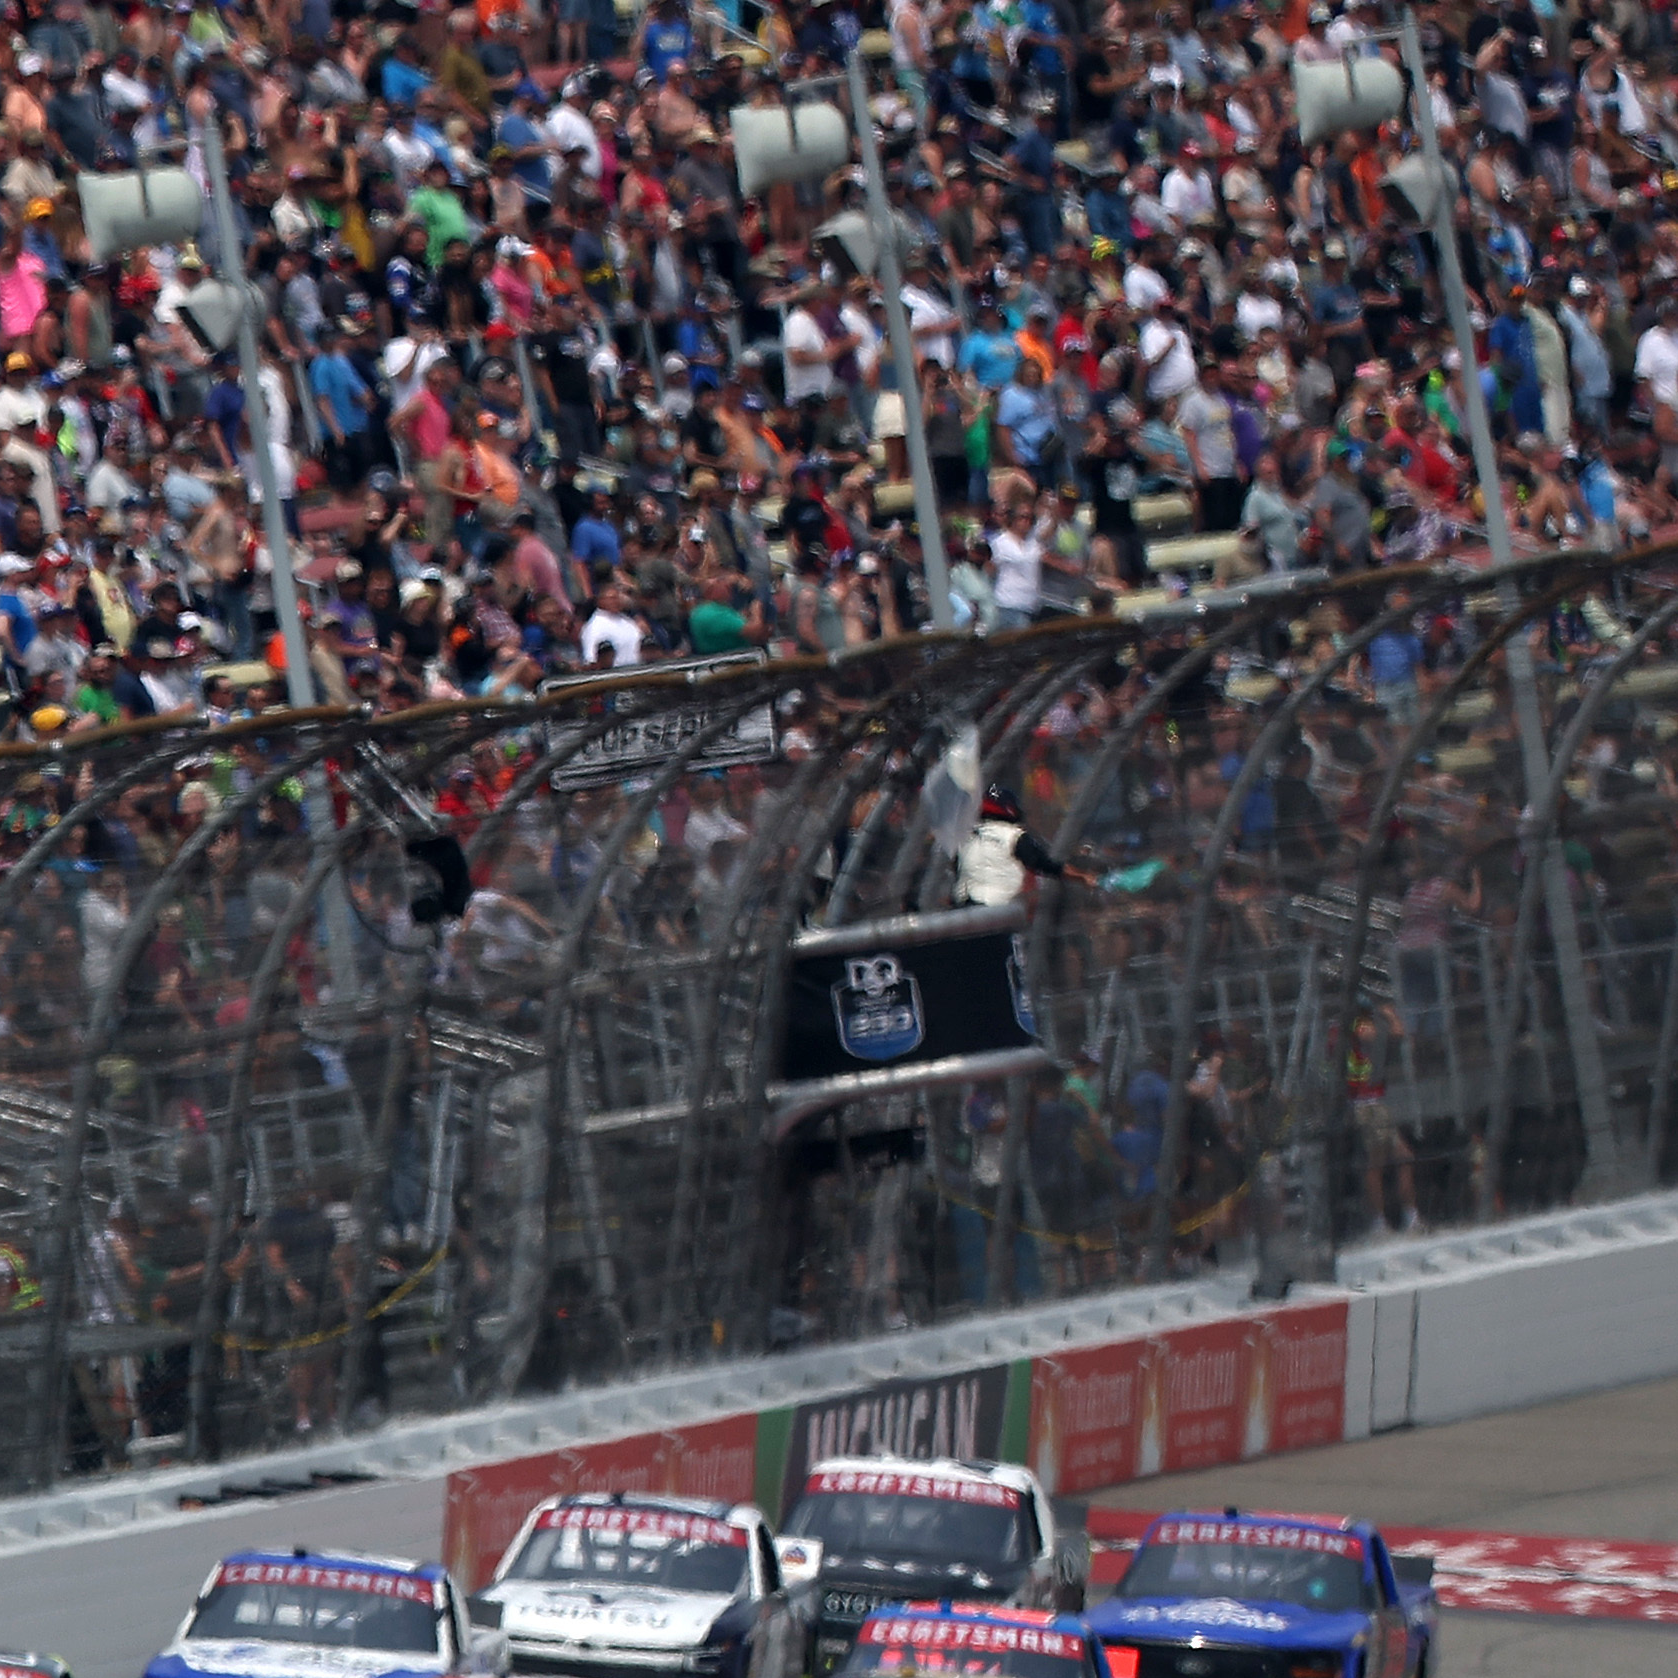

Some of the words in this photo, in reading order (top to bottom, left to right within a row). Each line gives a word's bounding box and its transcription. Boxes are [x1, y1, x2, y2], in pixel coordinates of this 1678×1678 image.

[819, 1473, 1004, 1506] CRAFTSMAN
[549, 1508, 735, 1543] CRAFTSMAN
[1157, 1522, 1344, 1553] CRAFTSMAN
[223, 1563, 413, 1595] CRAFTSMAN
[869, 1619, 1063, 1655] CRAFTSMAN
